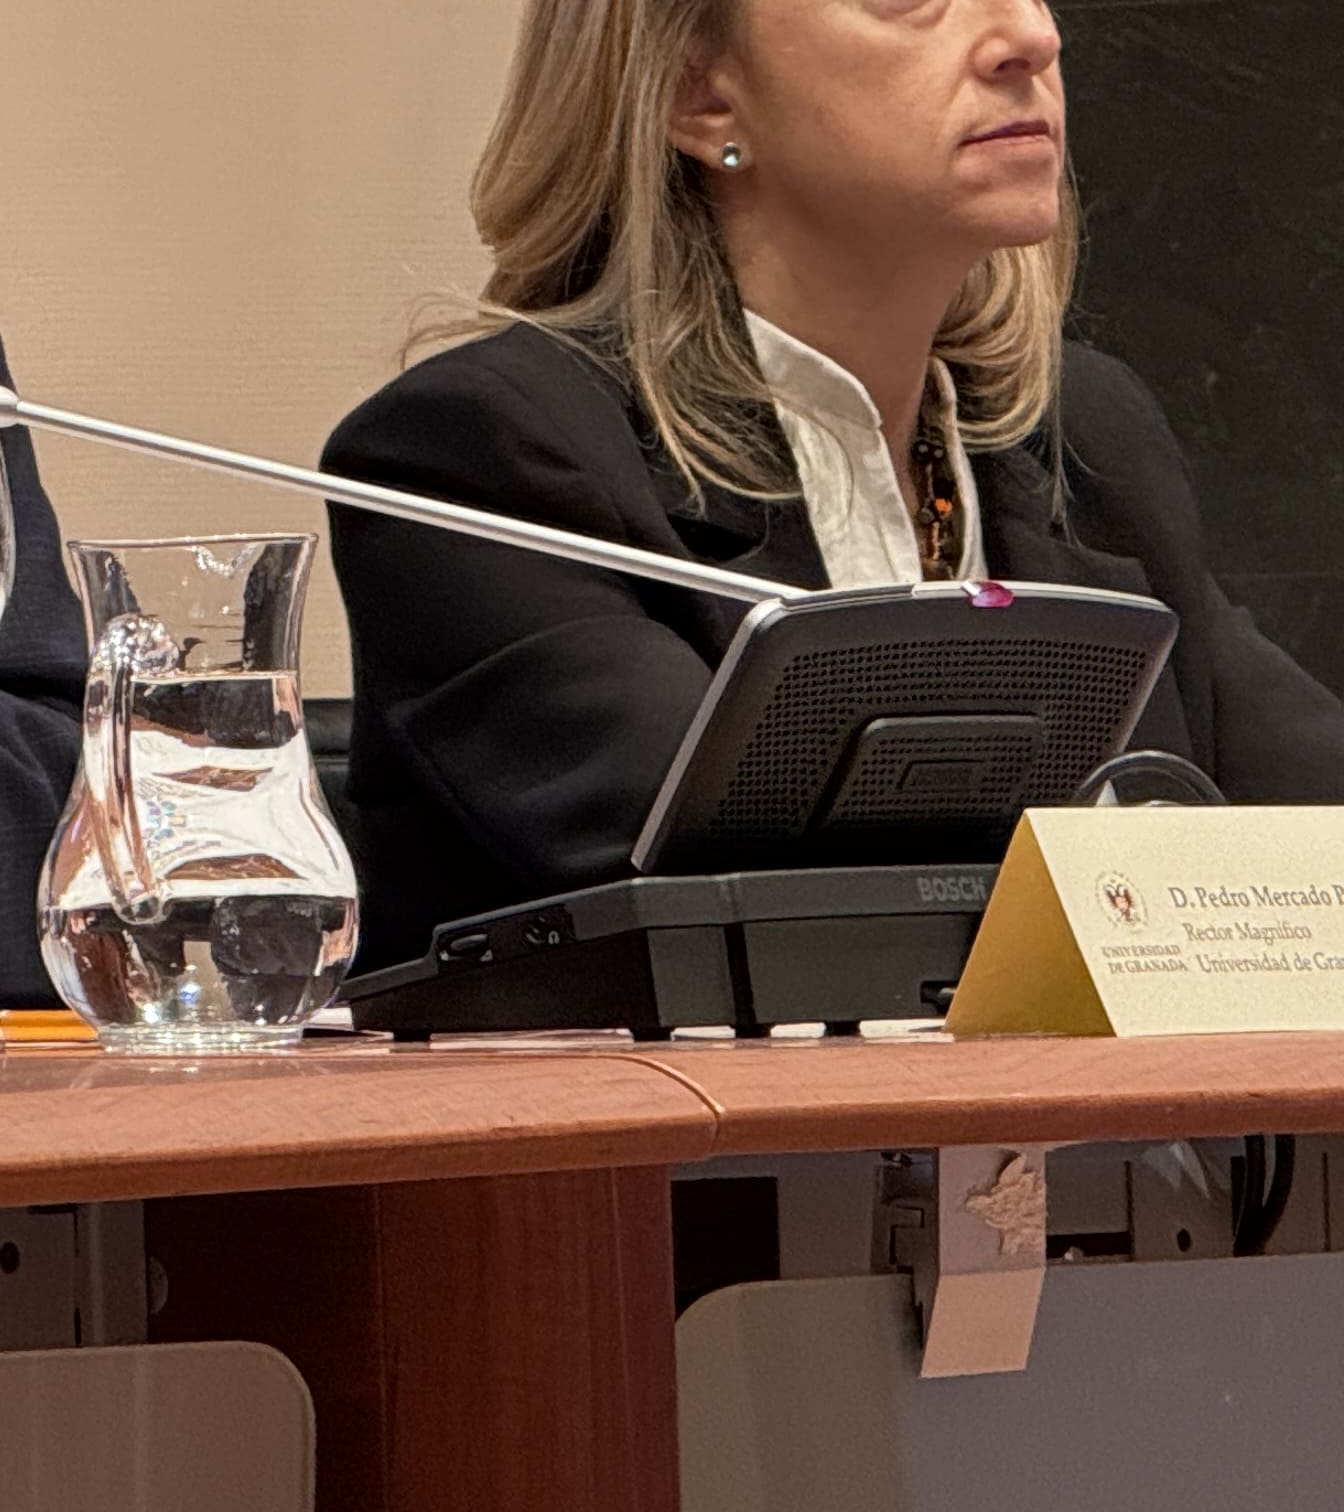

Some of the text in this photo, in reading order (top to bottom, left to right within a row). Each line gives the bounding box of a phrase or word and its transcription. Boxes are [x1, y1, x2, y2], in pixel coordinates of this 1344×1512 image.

[917, 876, 988, 902] BOSCH
[1168, 887, 1195, 908] D.
[1194, 885, 1250, 908] Pedro
[1249, 884, 1332, 907] Mercado
[1181, 919, 1312, 946] Rector Magnífico
[1101, 944, 1182, 959] UNIVERSIDAD
[1195, 952, 1293, 973] Universidad
[1293, 951, 1312, 972] de
[1125, 958, 1188, 973] GRANADA
